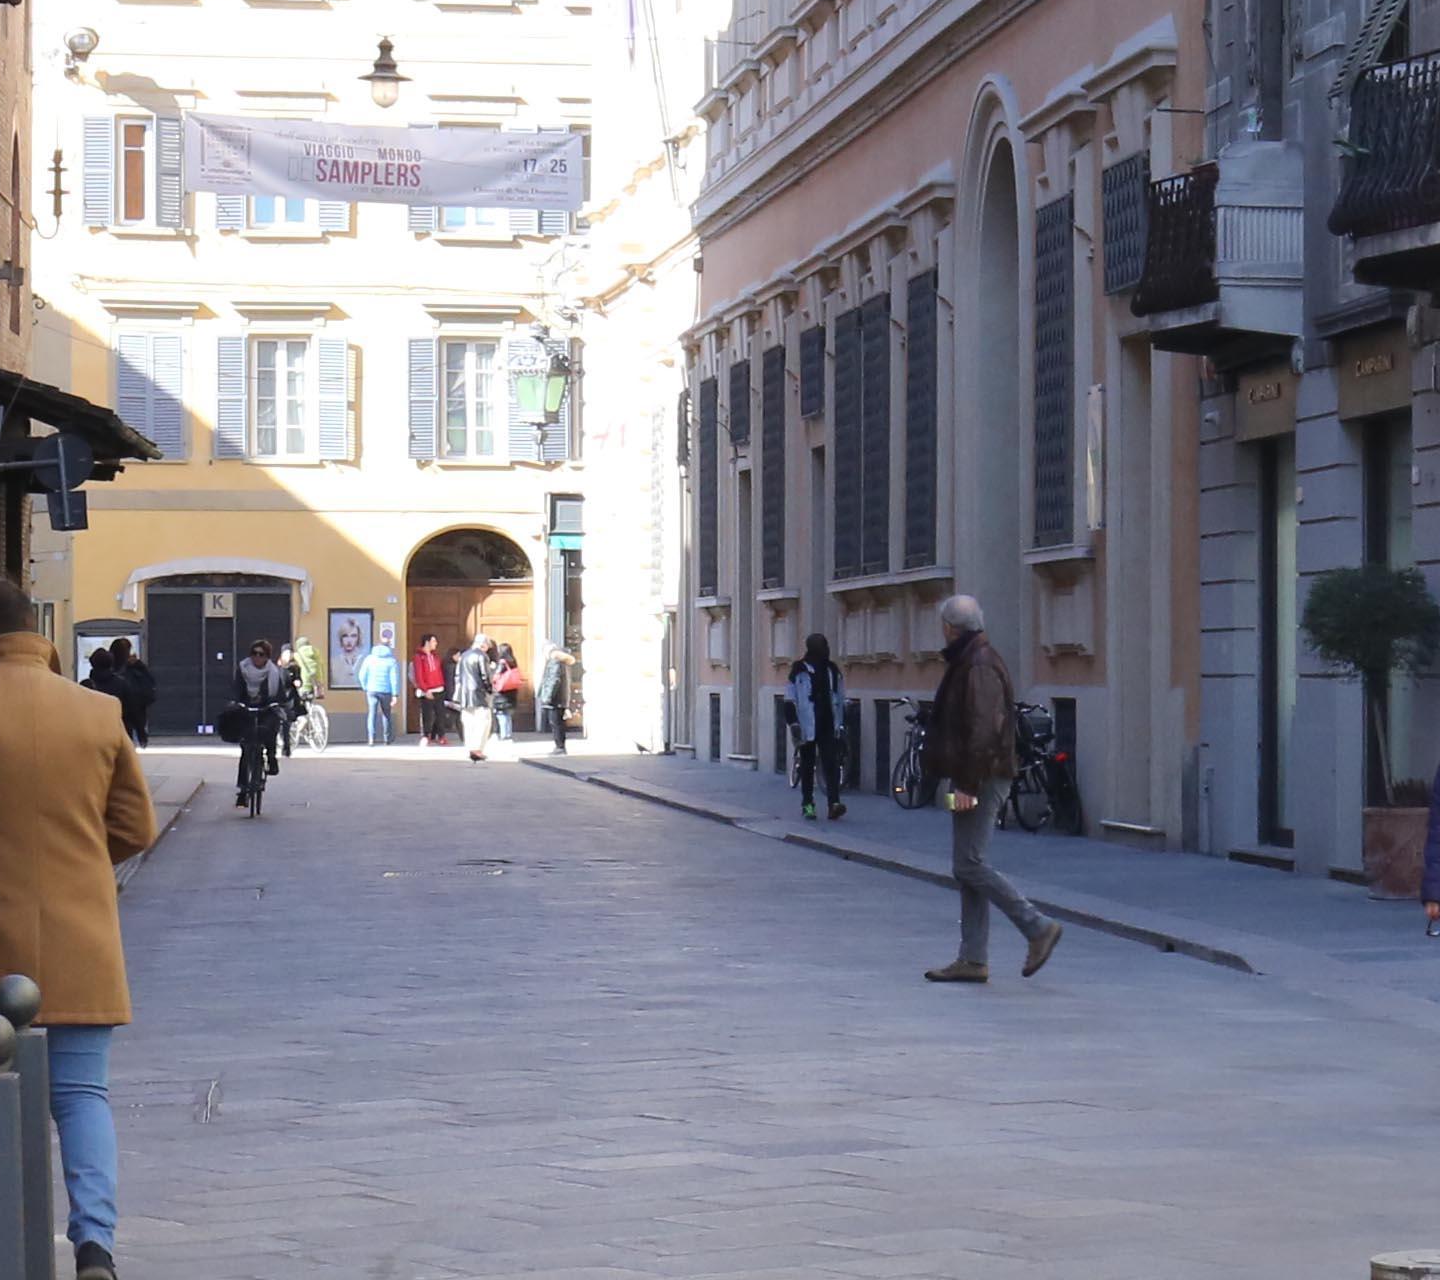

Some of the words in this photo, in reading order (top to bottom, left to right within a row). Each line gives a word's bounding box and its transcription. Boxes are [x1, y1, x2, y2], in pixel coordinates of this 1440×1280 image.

[303, 142, 355, 159] VIAGGIO
[377, 146, 422, 163] MONDO
[315, 157, 422, 188] SAMPLERS
[522, 158, 538, 172] 17
[549, 158, 568, 174] 25
